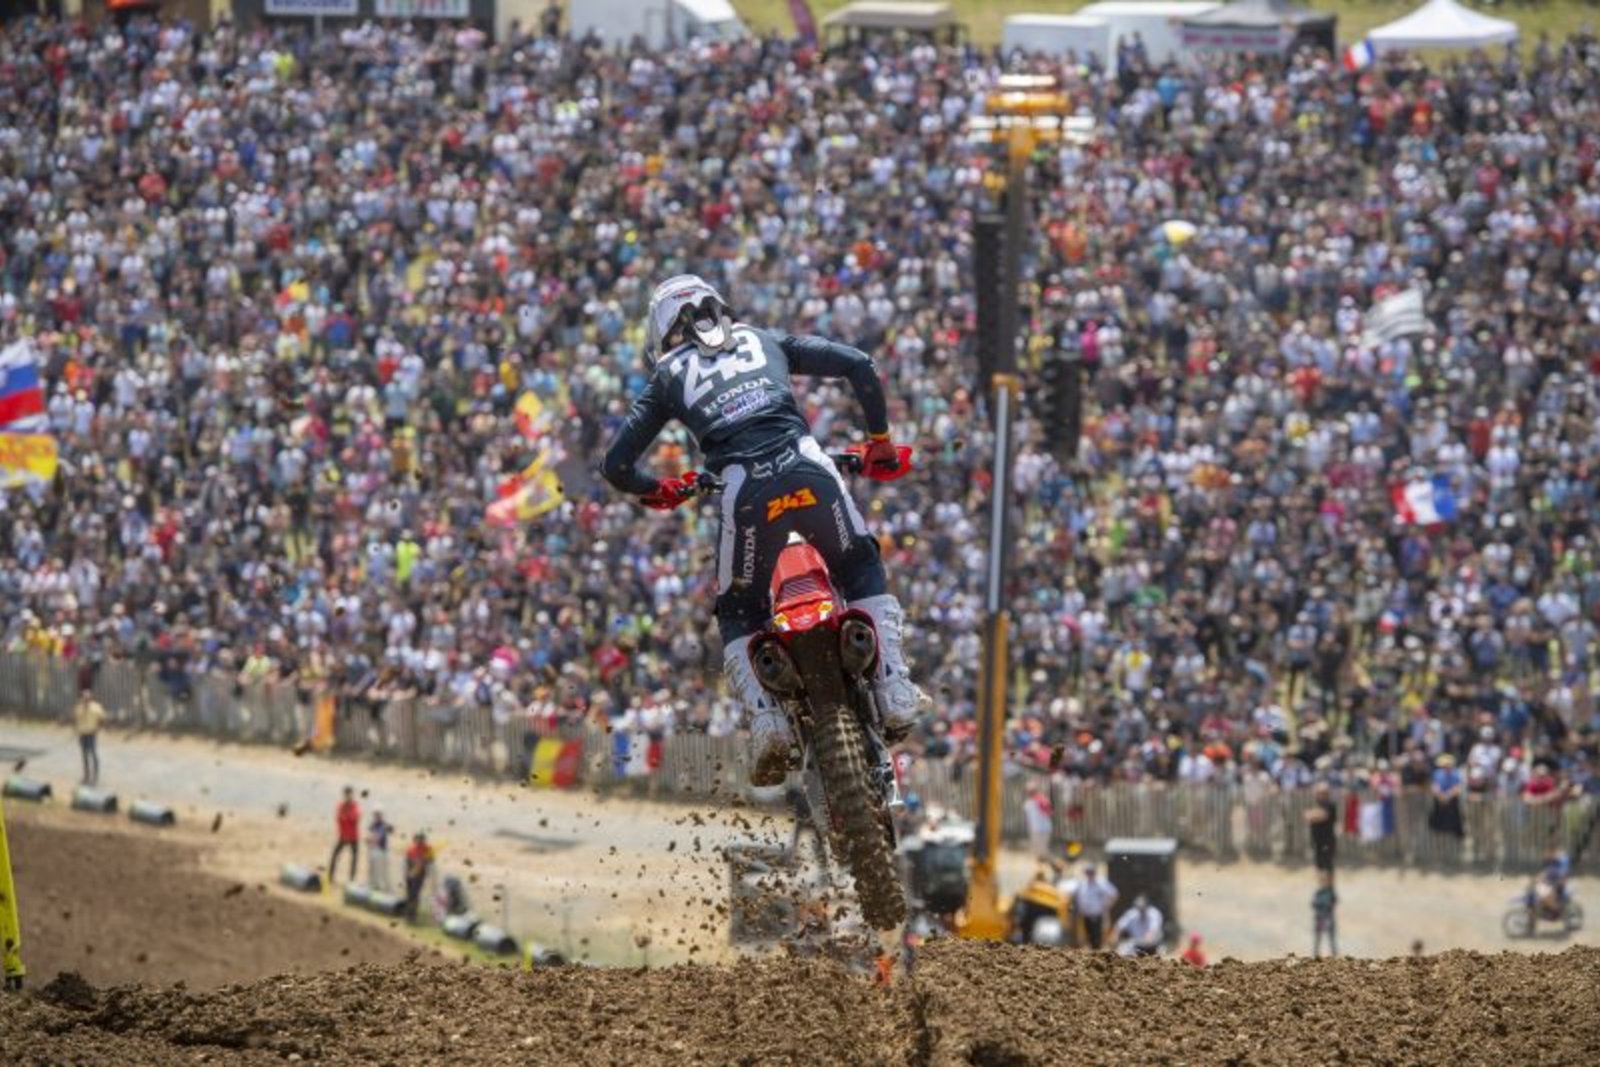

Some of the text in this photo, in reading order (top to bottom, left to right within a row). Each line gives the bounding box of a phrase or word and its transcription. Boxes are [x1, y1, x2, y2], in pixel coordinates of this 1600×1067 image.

[703, 377, 774, 416] HONDA
[766, 487, 817, 522] 243
[832, 499, 851, 552] HONDA
[742, 525, 757, 585] HONDA
